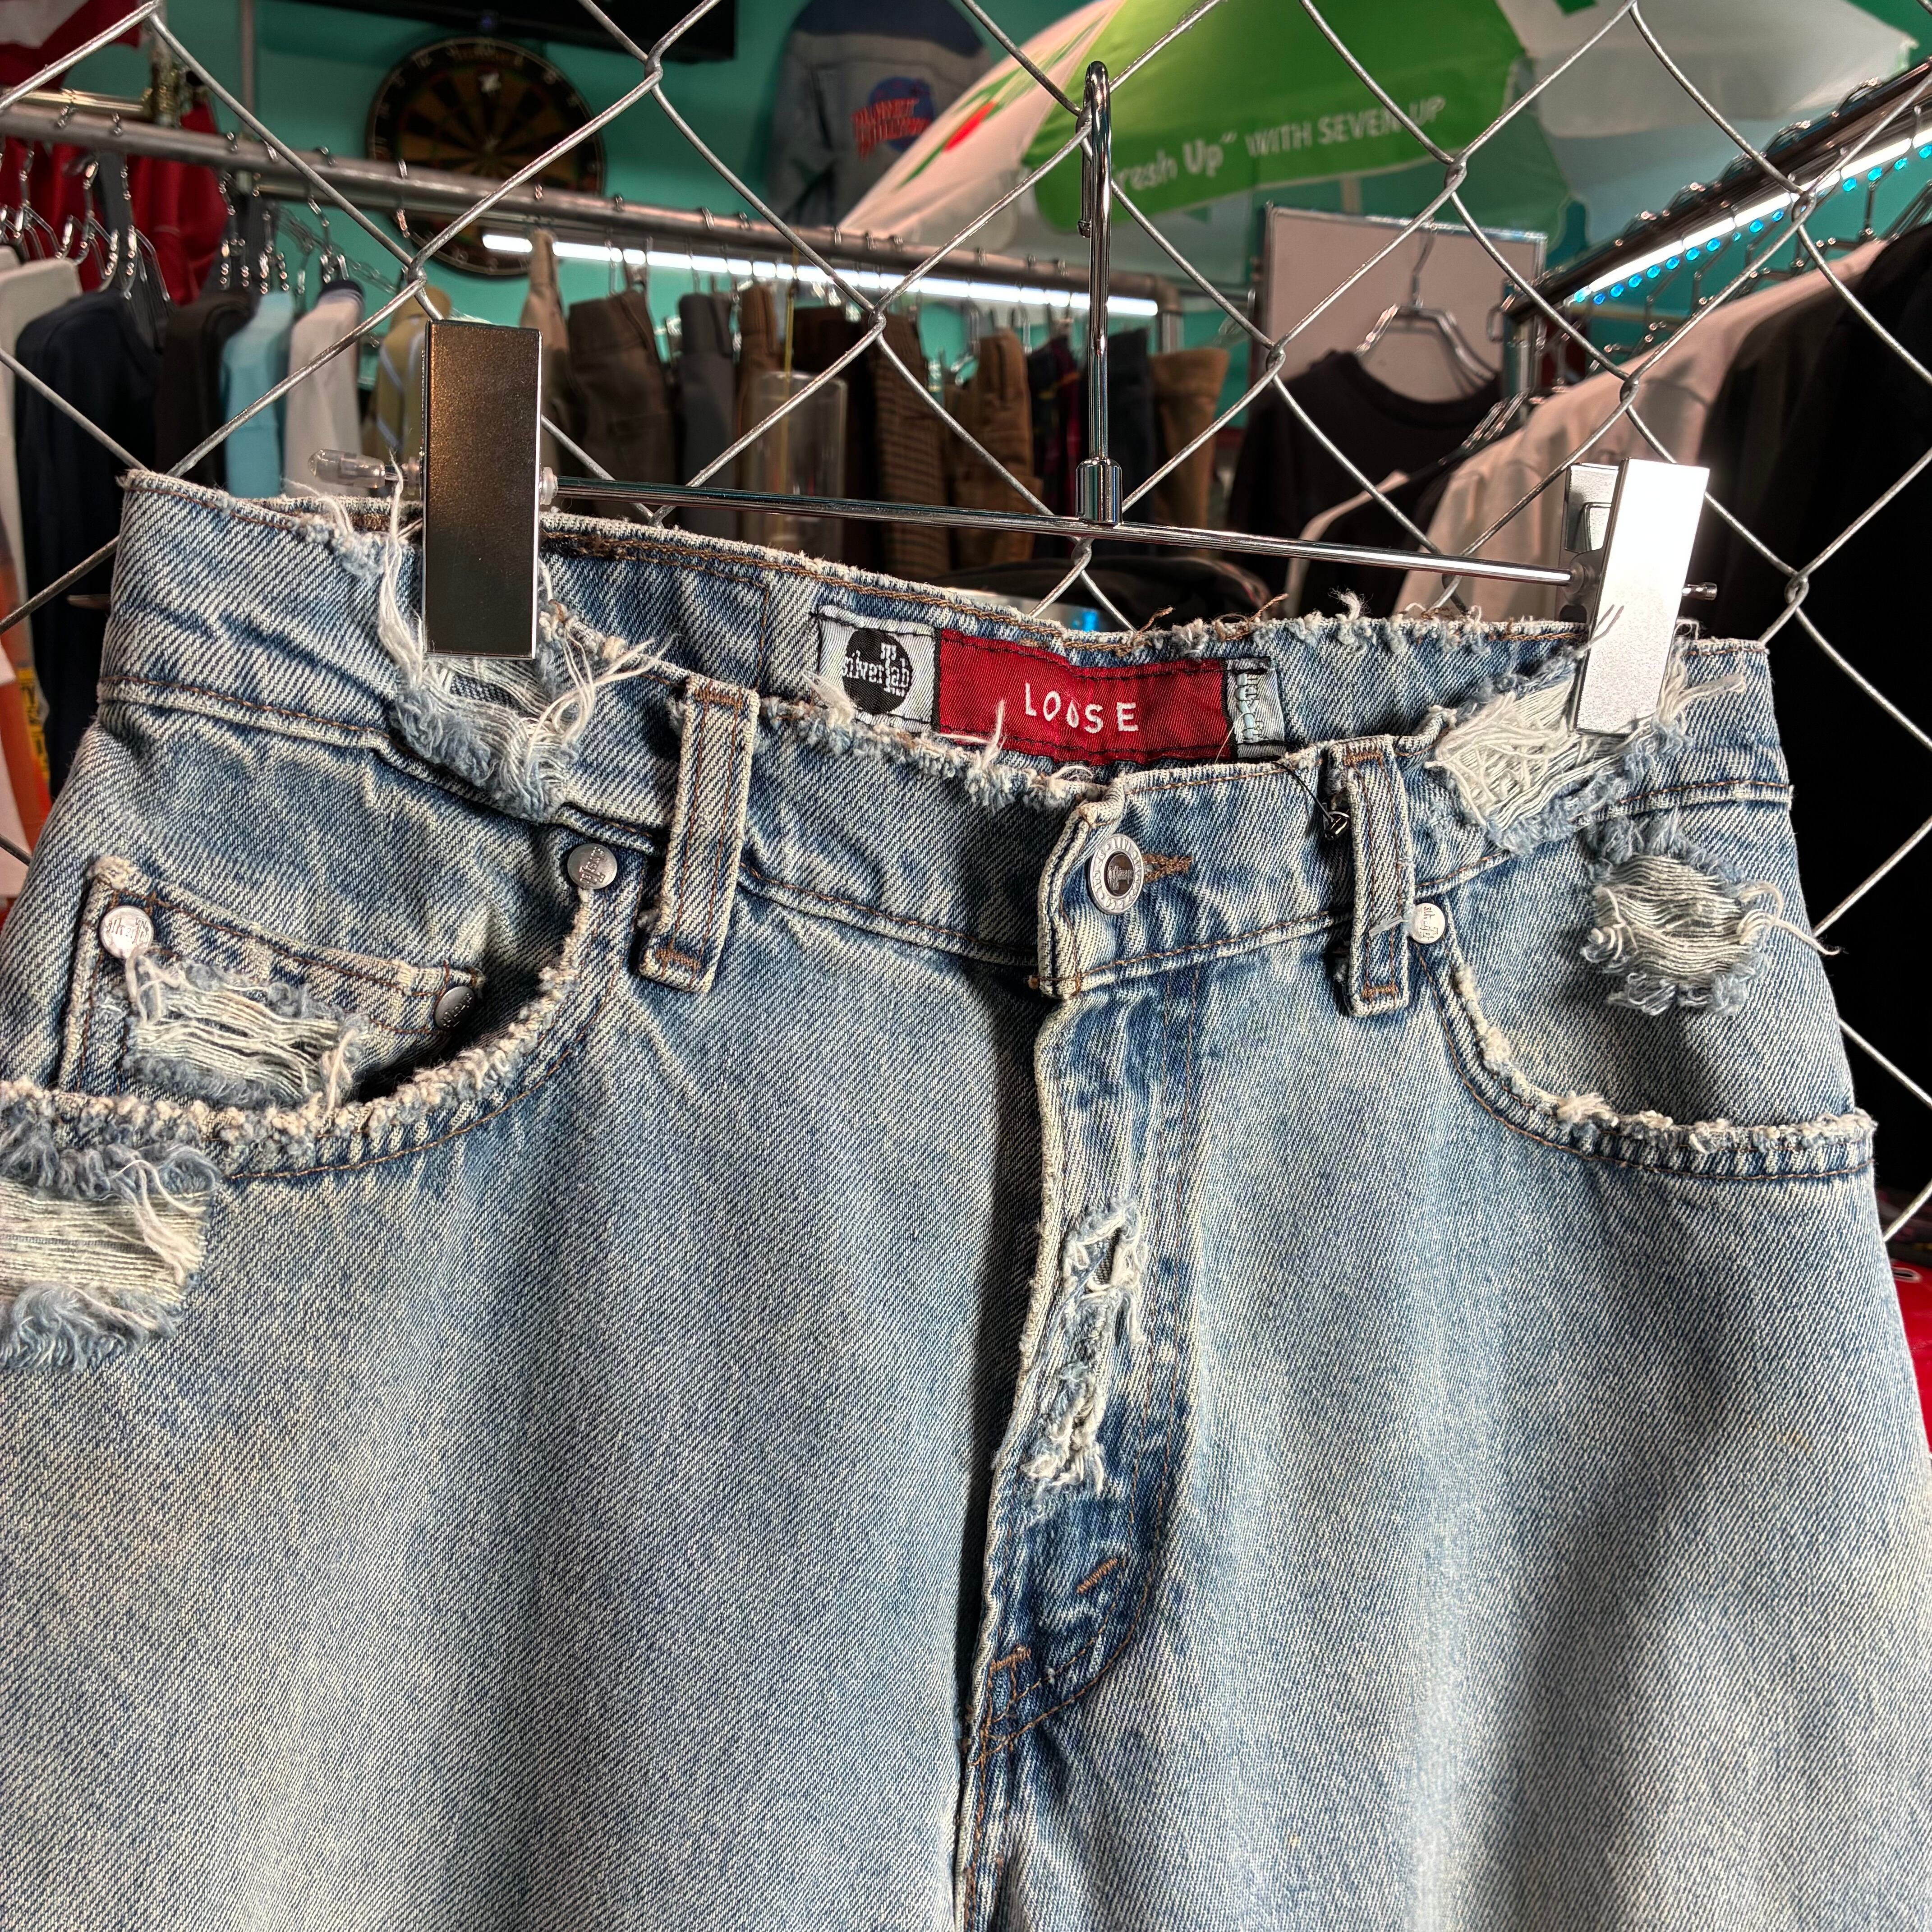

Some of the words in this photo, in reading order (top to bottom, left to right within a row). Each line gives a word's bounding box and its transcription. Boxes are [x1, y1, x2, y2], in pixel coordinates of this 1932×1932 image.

[1111, 148, 1178, 191] resh
[1244, 121, 1313, 158] WITH
[1317, 106, 1402, 145] SEVEN
[1409, 95, 1446, 127] UP
[1025, 682, 1139, 734] LOOSE
